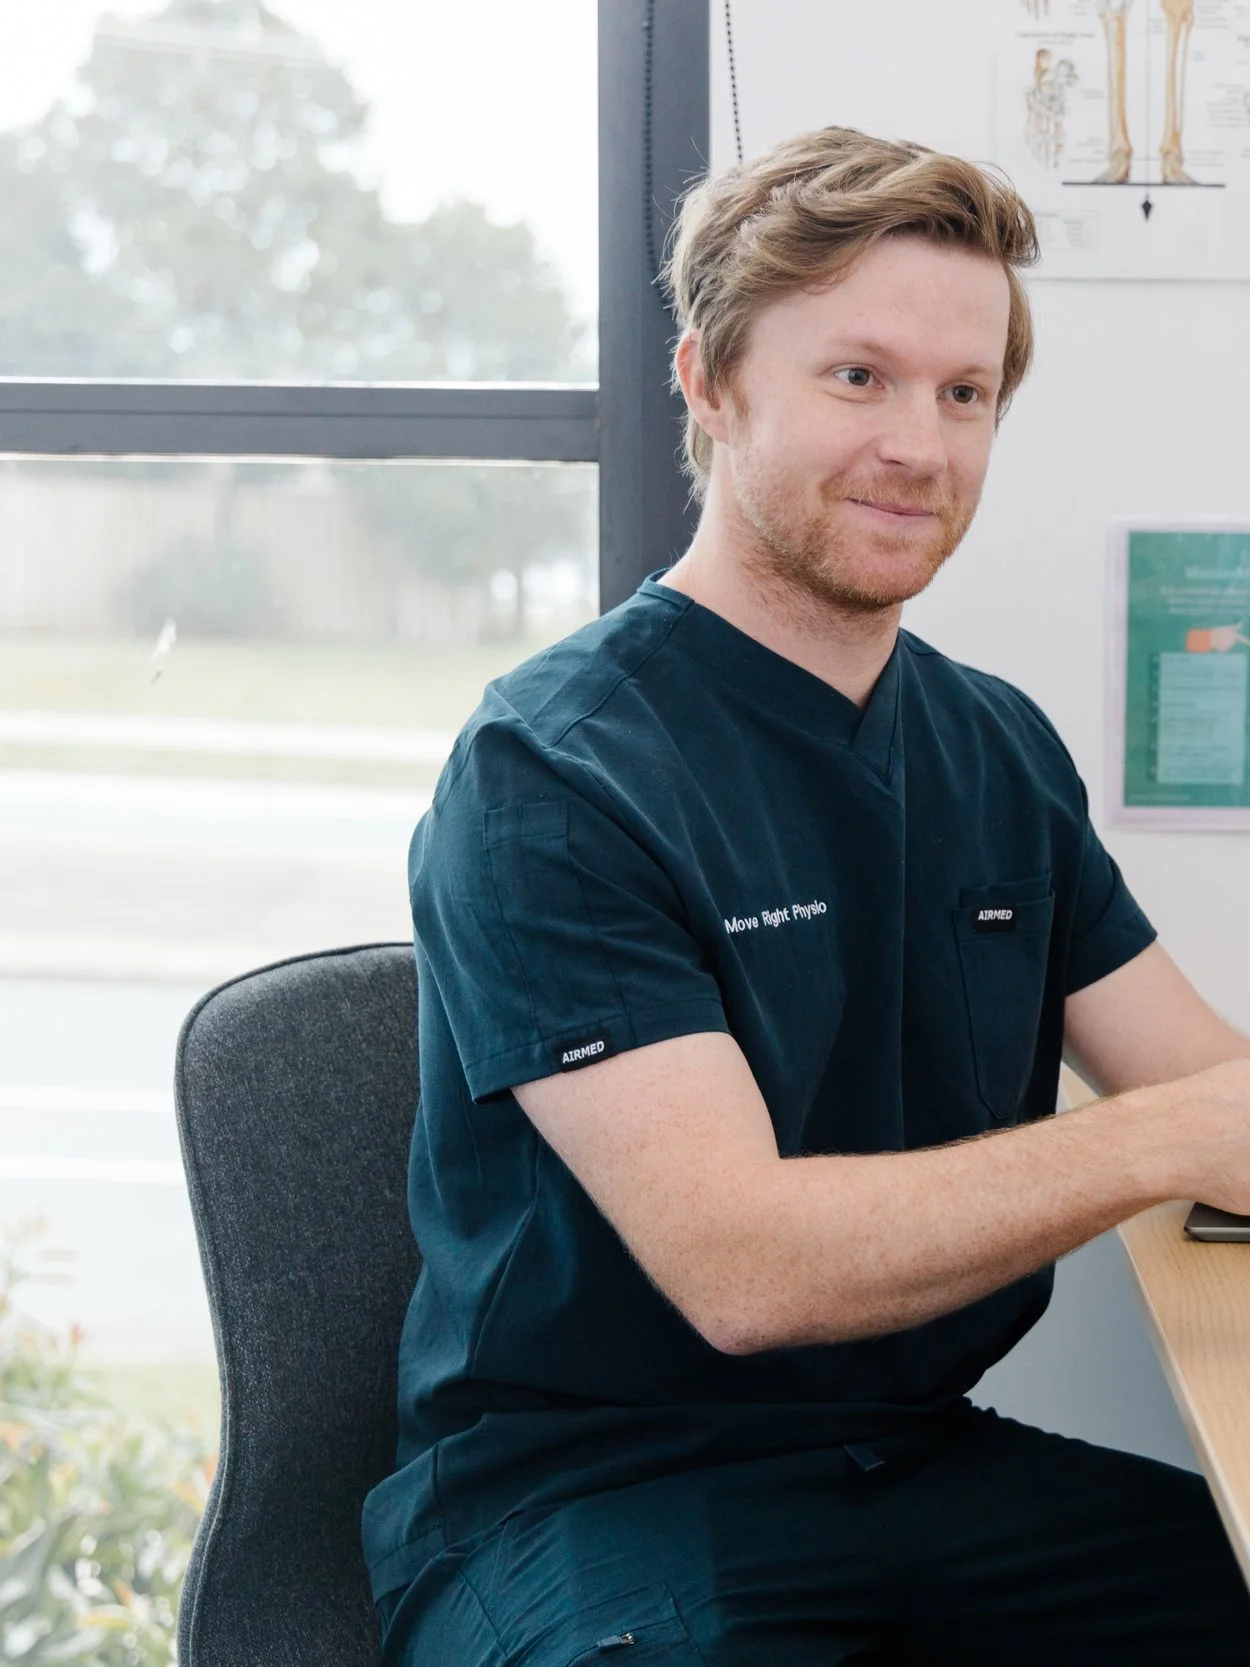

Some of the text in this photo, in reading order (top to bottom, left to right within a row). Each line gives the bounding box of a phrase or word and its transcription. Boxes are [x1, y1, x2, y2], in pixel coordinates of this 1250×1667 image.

[724, 899, 827, 934] Move Right Physio
[978, 909, 1013, 921] AIRMED
[562, 1040, 605, 1064] AIRMED
